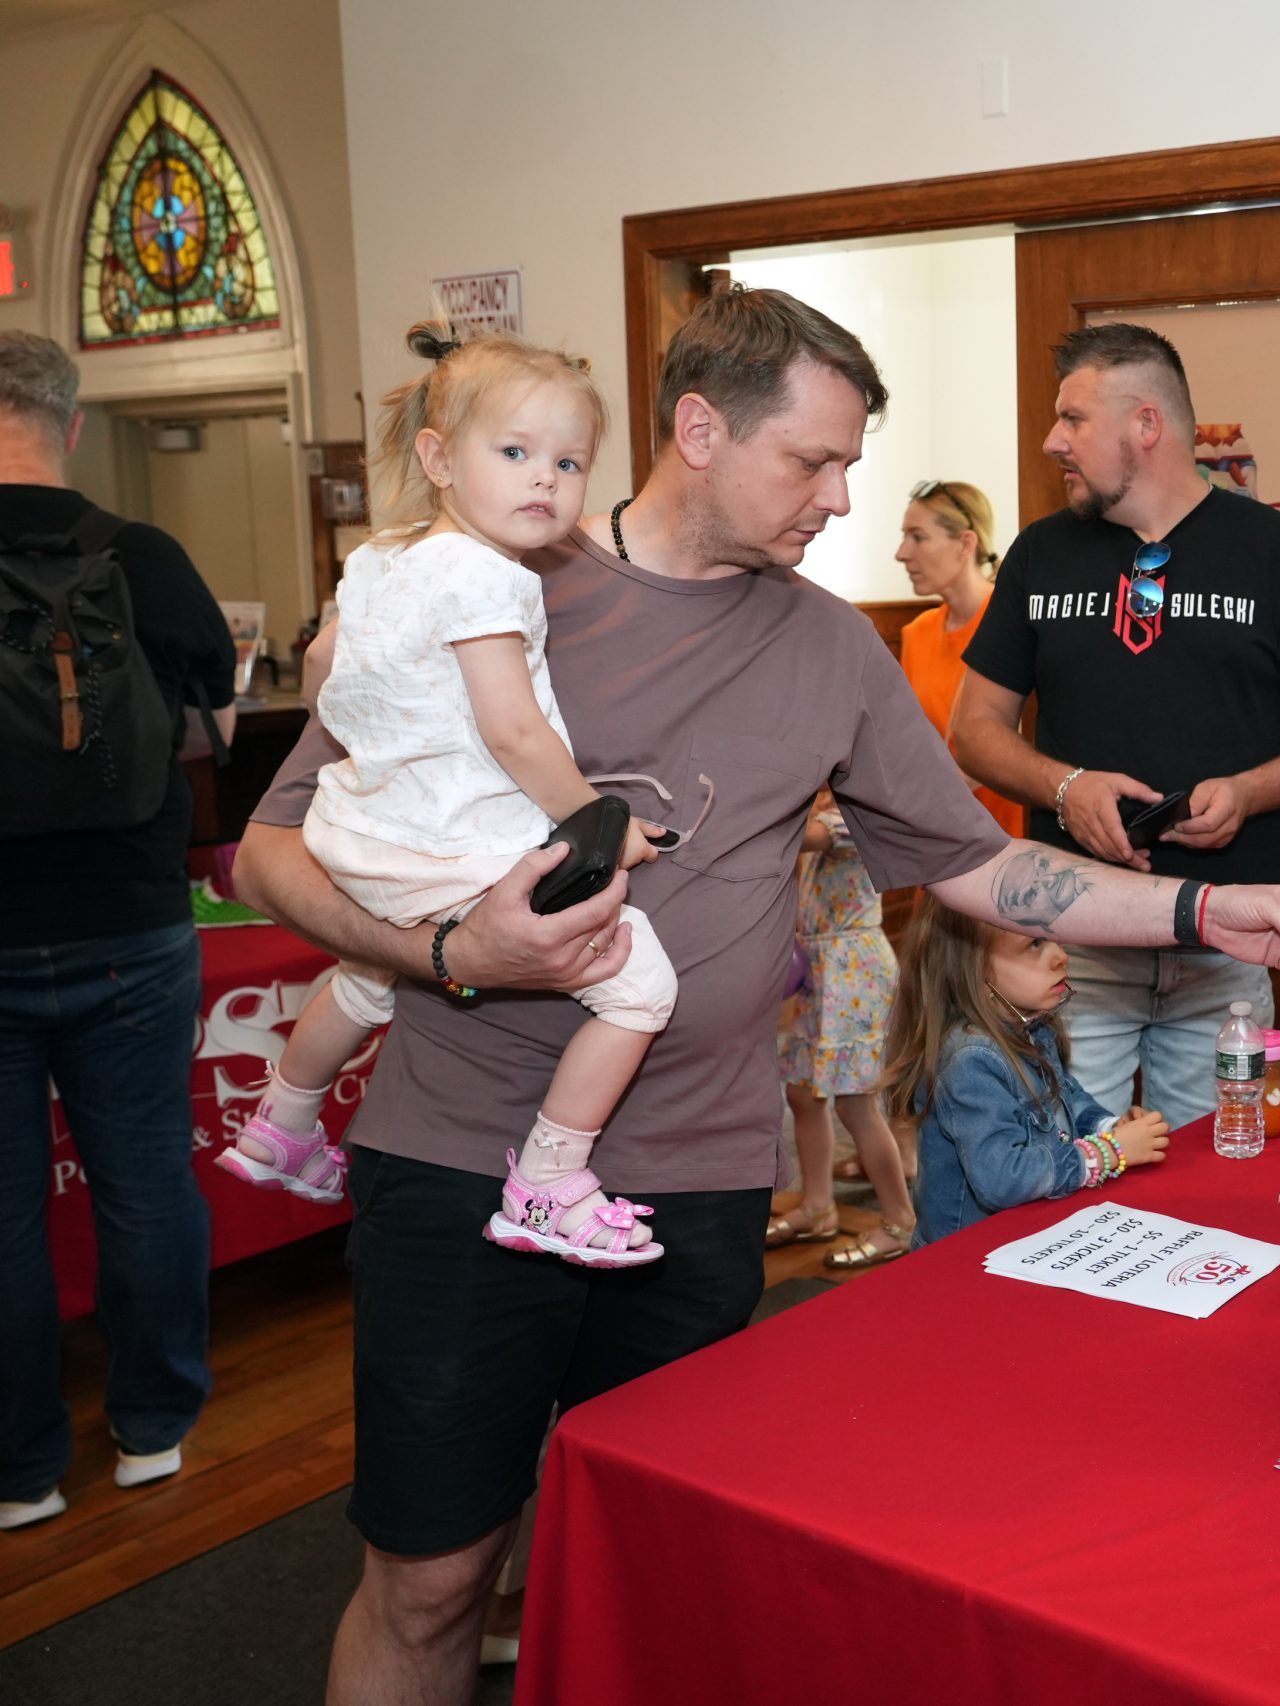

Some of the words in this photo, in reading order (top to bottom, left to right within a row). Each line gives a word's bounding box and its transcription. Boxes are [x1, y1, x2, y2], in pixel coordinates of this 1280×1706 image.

[441, 278, 508, 314] OCCUPANCY
[1028, 591, 1110, 621] MACIEJ
[1093, 1210, 1121, 1225] $20
[1116, 1218, 1143, 1234] $10
[1069, 1228, 1089, 1239] 10
[1142, 1230, 1164, 1241] $5
[1158, 1229, 1204, 1256] RAFFLE
[1021, 1236, 1069, 1266] TICKETS
[1050, 1241, 1104, 1271] TICKETS
[1085, 1249, 1130, 1275] TICKET
[1101, 1258, 1151, 1288] LOTERIA
[1195, 1260, 1232, 1281] 50
